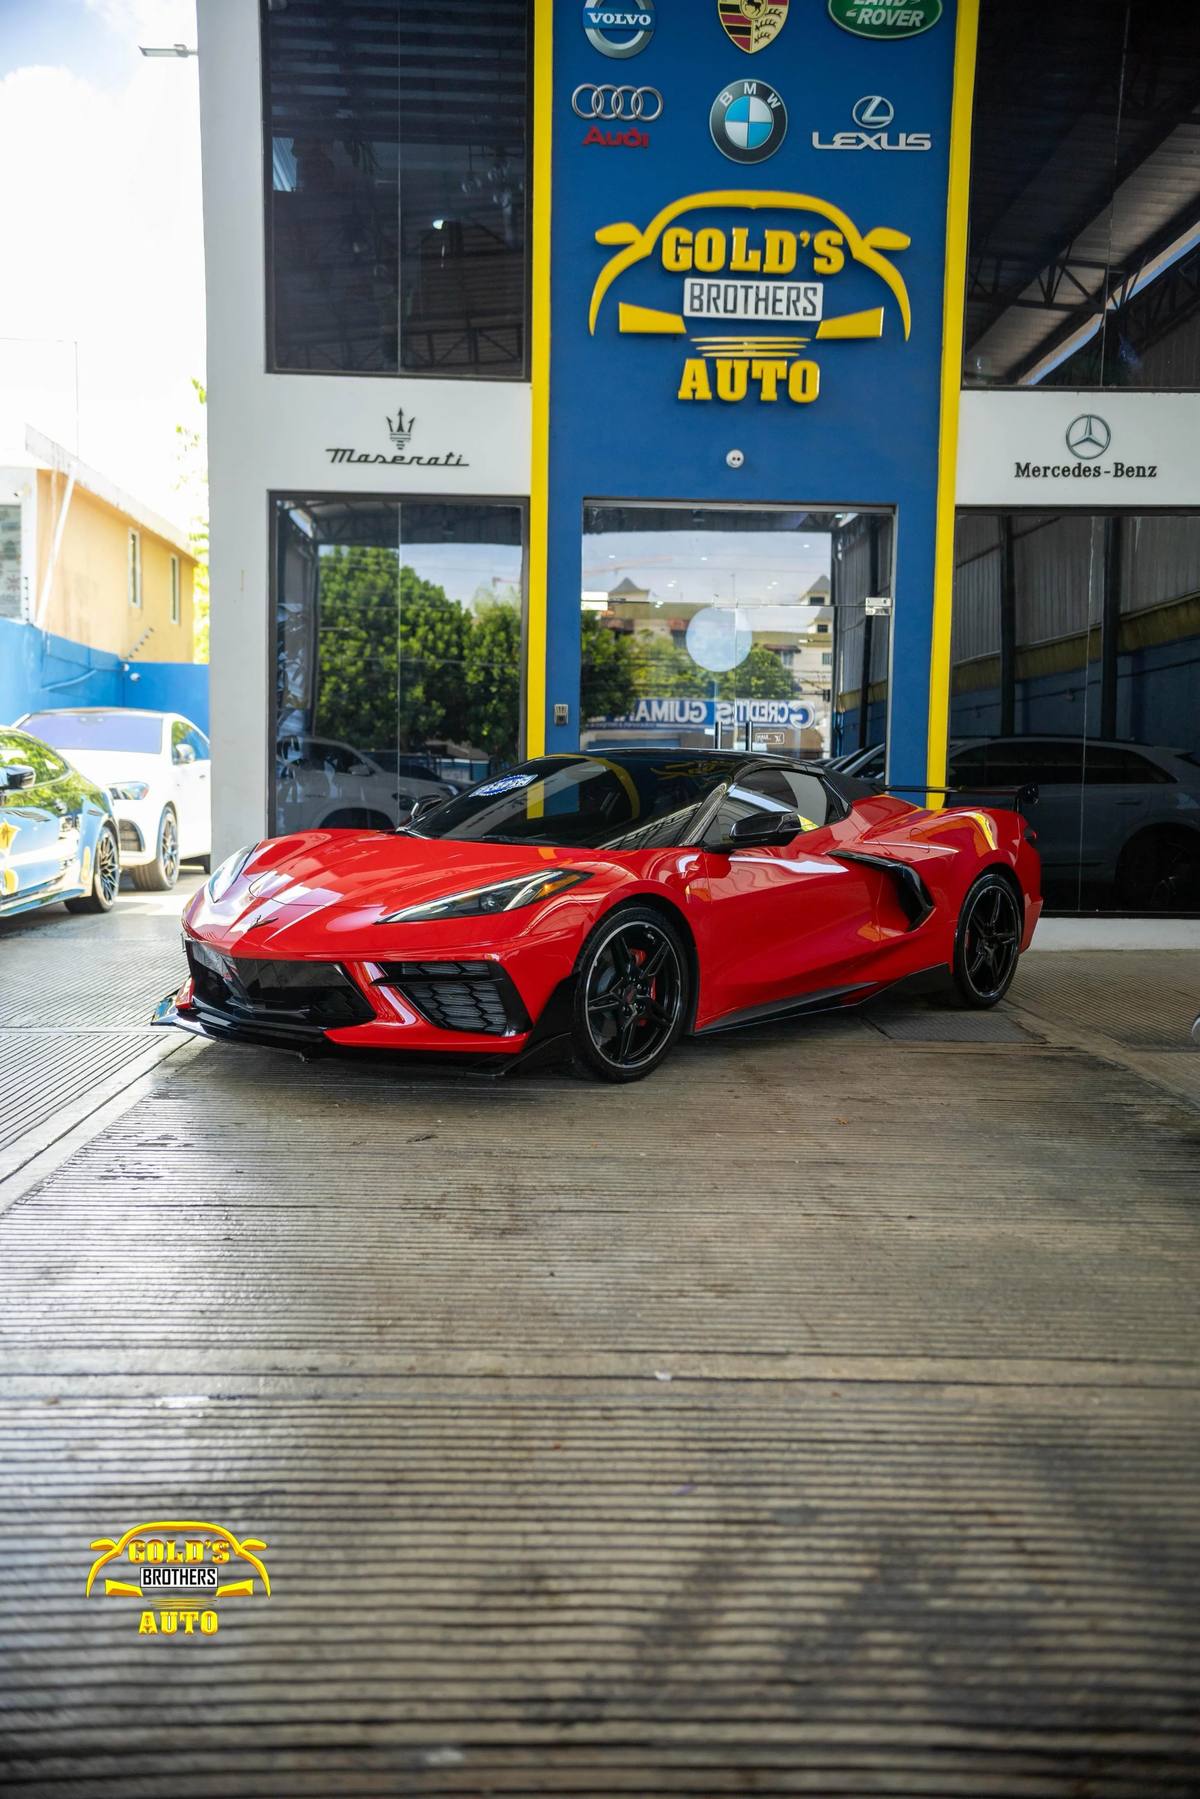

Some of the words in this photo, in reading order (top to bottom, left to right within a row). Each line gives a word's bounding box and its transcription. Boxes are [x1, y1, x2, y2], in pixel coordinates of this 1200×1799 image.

[587, 11, 652, 27] VOLVO
[856, 8, 925, 27] ROVER
[719, 82, 782, 109] BMW
[812, 131, 932, 151] LEXUS
[661, 226, 845, 275] GOLD'S
[689, 281, 819, 317] BROTHERS
[677, 357, 820, 404] AUTO
[325, 448, 470, 467] Maserati
[1014, 461, 1158, 478] Mercedes-Benz
